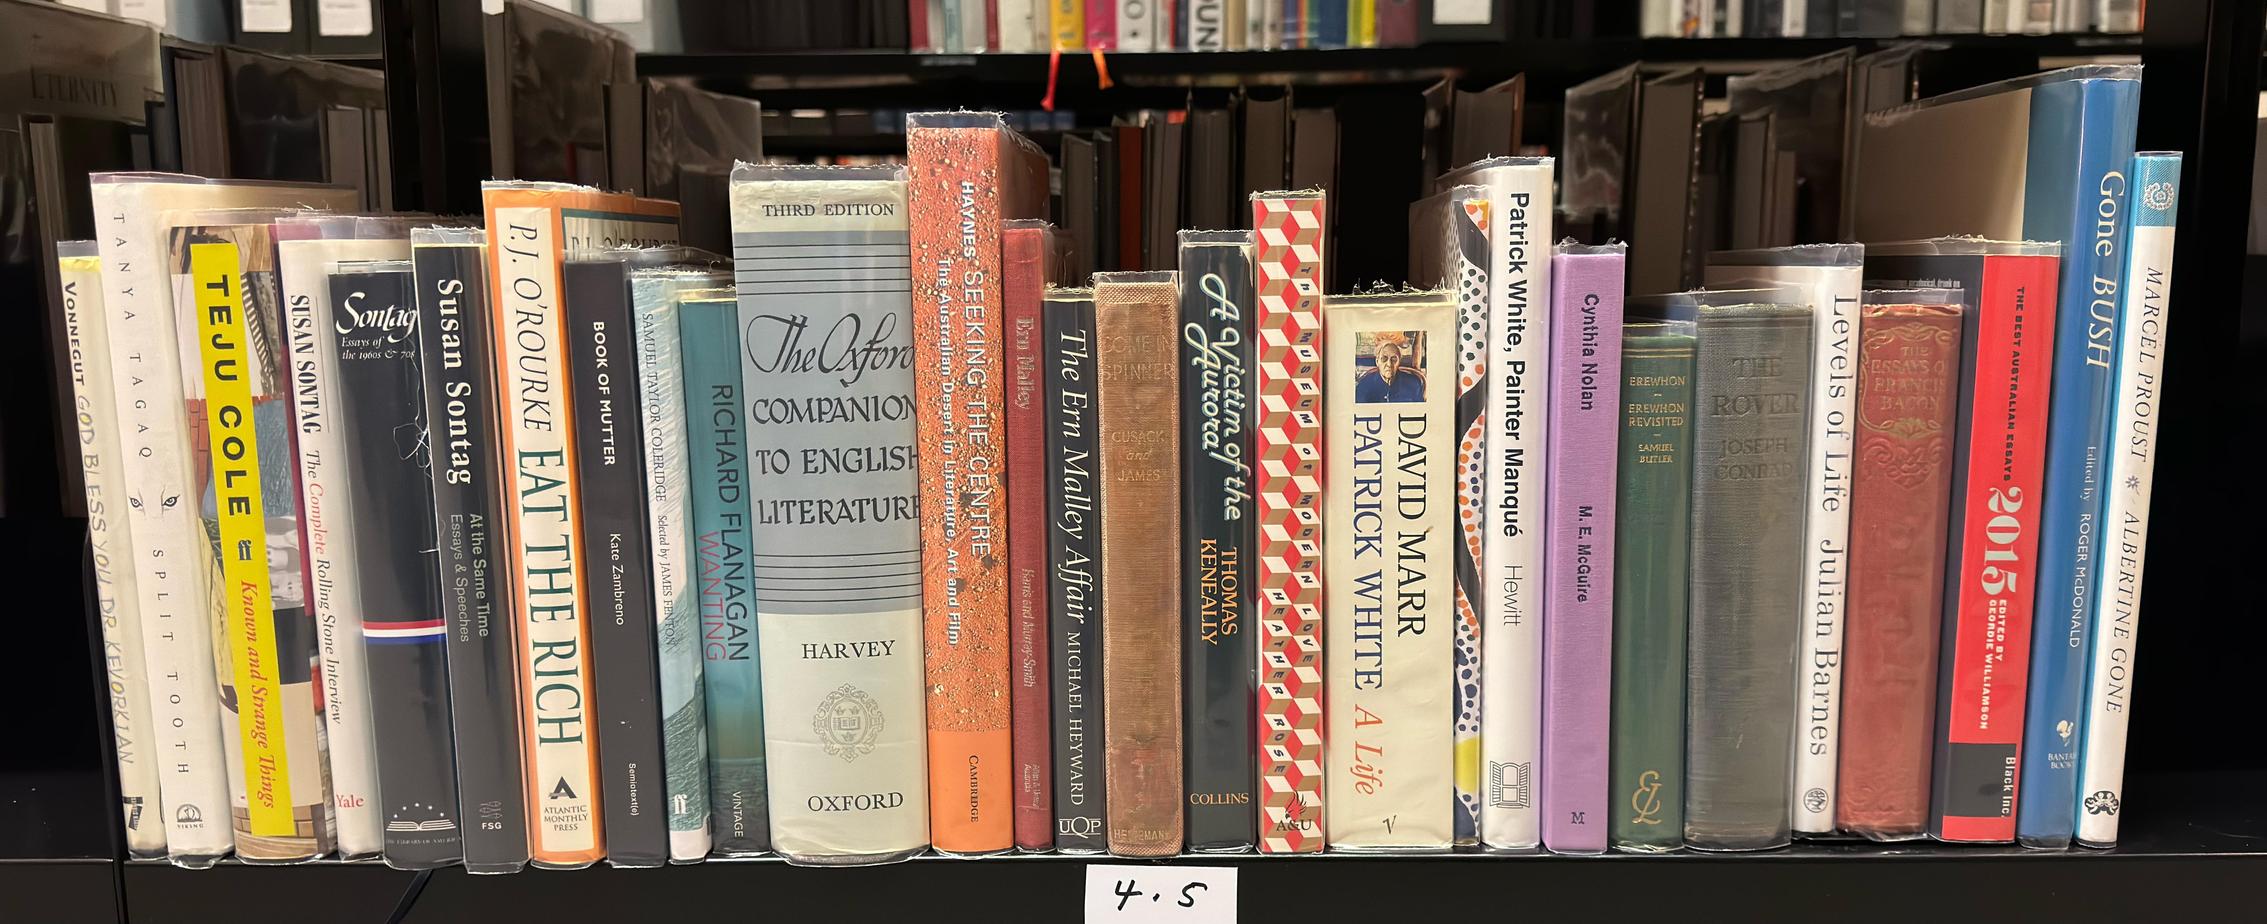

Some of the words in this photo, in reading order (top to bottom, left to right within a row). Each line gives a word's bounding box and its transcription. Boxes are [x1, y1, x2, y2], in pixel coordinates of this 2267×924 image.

[762, 203, 816, 217] THIRD
[824, 203, 895, 216] EDITION
[960, 180, 976, 259] HAYNES
[1508, 192, 1530, 274] Patrick
[2095, 170, 2126, 257] Gone
[937, 258, 952, 288] The
[1200, 273, 1240, 321] A
[2015, 286, 2025, 311] THE
[64, 281, 85, 386] VONNEGUT
[113, 213, 135, 320] TANYA
[129, 353, 152, 458] TAGAQ
[206, 275, 238, 382] TEJU
[290, 294, 315, 354] SUSAN
[335, 291, 418, 344] Sontag
[341, 336, 370, 349] Essays
[437, 279, 464, 370] Susan
[642, 313, 658, 369] SAMUEL
[746, 312, 817, 374] The
[938, 293, 952, 376] Australian
[963, 270, 987, 387] SEEKING
[1015, 317, 1035, 351] Ern
[1503, 279, 1528, 352] White,
[1580, 293, 1600, 358] Cynthia
[2012, 315, 2023, 348] BEST
[2086, 274, 2117, 369] BUSH
[2138, 267, 2164, 364] MARCEL
[358, 351, 382, 361] 1960s
[513, 277, 552, 432] O'ROURKE
[592, 321, 608, 369] BOOK
[1059, 329, 1089, 382] The
[1102, 363, 1173, 382] SPINNER
[1732, 357, 1784, 381] THE
[1828, 293, 1858, 399] Levels
[1871, 359, 1931, 374] ESSAYS
[297, 360, 321, 434] SONTAG
[598, 374, 611, 396] OF
[648, 372, 661, 424] TAYLOR
[752, 394, 917, 425] COMPANION
[941, 381, 955, 434] Desert
[1014, 354, 1037, 410] Malley
[1184, 322, 1222, 451] Aurora
[1209, 327, 1246, 438] Victim
[1505, 360, 1526, 441] Painter
[1581, 362, 1598, 411] Nolan
[1628, 402, 1685, 414] EREWHON
[1629, 376, 1686, 387] EREWHON
[1711, 392, 1801, 418] ROVER
[2007, 350, 2020, 430] AUSTRALIAN
[77, 395, 95, 445] GOD
[445, 381, 473, 484] Sontag
[599, 399, 616, 466] MUTTER
[967, 395, 988, 448] THE
[1062, 388, 1088, 438] Ern
[1111, 430, 1166, 443] CUSACK
[1628, 416, 1684, 427] REVISITED
[1826, 411, 1851, 441] of
[2130, 371, 2154, 463] PROUST
[219, 405, 251, 516] COLE
[306, 450, 319, 479] The
[651, 427, 667, 502] COLERIDGE
[711, 384, 741, 504] RICHARD
[756, 448, 790, 475] TO
[1208, 442, 1252, 478] of
[1397, 413, 1428, 520] DAVID
[1638, 443, 1675, 453] SAMUEL
[1639, 455, 1673, 464] BUTLER
[2003, 433, 2015, 482] ESSAYS
[2084, 446, 2097, 484] Edited
[84, 454, 107, 533] BLESS
[518, 447, 568, 523] EAT
[1057, 445, 1092, 540] Malley
[1223, 476, 1252, 521] the
[1353, 413, 1383, 560] PATRICK
[1499, 448, 1524, 537] Manqué
[1714, 463, 1793, 482] CONRAD
[1822, 450, 1850, 513] Life
[308, 483, 327, 555] Complete
[469, 513, 480, 529] At
[943, 461, 956, 542] Literature,
[968, 457, 992, 557] CENTRE
[450, 513, 463, 560] Essays
[471, 531, 483, 555] the
[609, 533, 621, 561] Kate
[657, 515, 668, 546] Selected
[1981, 486, 2024, 596] 2015
[2077, 513, 2092, 562] ROGER
[93, 540, 112, 584] YOU
[316, 558, 333, 610] Rolling
[473, 558, 487, 599] Same
[525, 533, 575, 623] THE
[660, 562, 673, 597] JAMES
[719, 513, 750, 661] FLANAGAN
[946, 548, 959, 574] Art
[1058, 545, 1094, 624] Affair
[1397, 531, 1427, 638] MARR
[1576, 544, 1592, 603] McGuire
[1816, 539, 1844, 639] Julian
[2113, 511, 2140, 640] ALBERTINE
[241, 580, 259, 643] Known
[453, 577, 469, 642] Speeches
[612, 565, 625, 626] Zambreno
[699, 531, 727, 661] WANTING
[947, 579, 960, 608] and
[1200, 538, 1218, 646] KENEALLY
[1220, 546, 1238, 636] THOMAS
[1503, 565, 1523, 627] Hewitt
[2069, 567, 2087, 648] McDONALD
[322, 613, 336, 655] Stone
[476, 602, 489, 638] Time
[948, 612, 962, 645] Film
[1271, 591, 1286, 696] HEATHER
[1301, 607, 1314, 663] LOVE
[1353, 568, 1383, 690] WHITE
[1985, 599, 1998, 650] GEORDIE
[1996, 599, 2007, 642] EDITED
[152, 550, 174, 641] SPLIT
[167, 672, 189, 773] TOOTH
[248, 650, 268, 681] and
[801, 639, 896, 659] HARVEY
[1067, 631, 1083, 713] MICHAEL
[104, 641, 134, 764] KEVORKIAN
[326, 658, 341, 725] Interview
[532, 636, 583, 747] RICH
[1808, 646, 1840, 757] Barnes
[1979, 653, 1994, 730] WILLIAMSON
[2106, 648, 2128, 713] GONE
[250, 685, 268, 749] Strange
[1354, 703, 1384, 729] A
[1069, 719, 1085, 806] HEYWARD
[1273, 717, 1285, 773] ROSE
[1349, 740, 1384, 796] Life
[256, 754, 275, 809] Things
[335, 794, 365, 808] Yale
[807, 791, 904, 813] OXFORD
[968, 754, 979, 823] CAMBRIDGE
[1189, 791, 1249, 806] COLLINS
[2003, 756, 2016, 792] Black
[481, 822, 503, 830] FSG
[544, 804, 588, 814] ATLANTIC
[544, 813, 589, 823] MONTHLY
[553, 823, 579, 832] PRESS
[732, 791, 744, 838] VINTAGE
[1058, 816, 1102, 839] UQP
[1276, 818, 1313, 832] A&U
